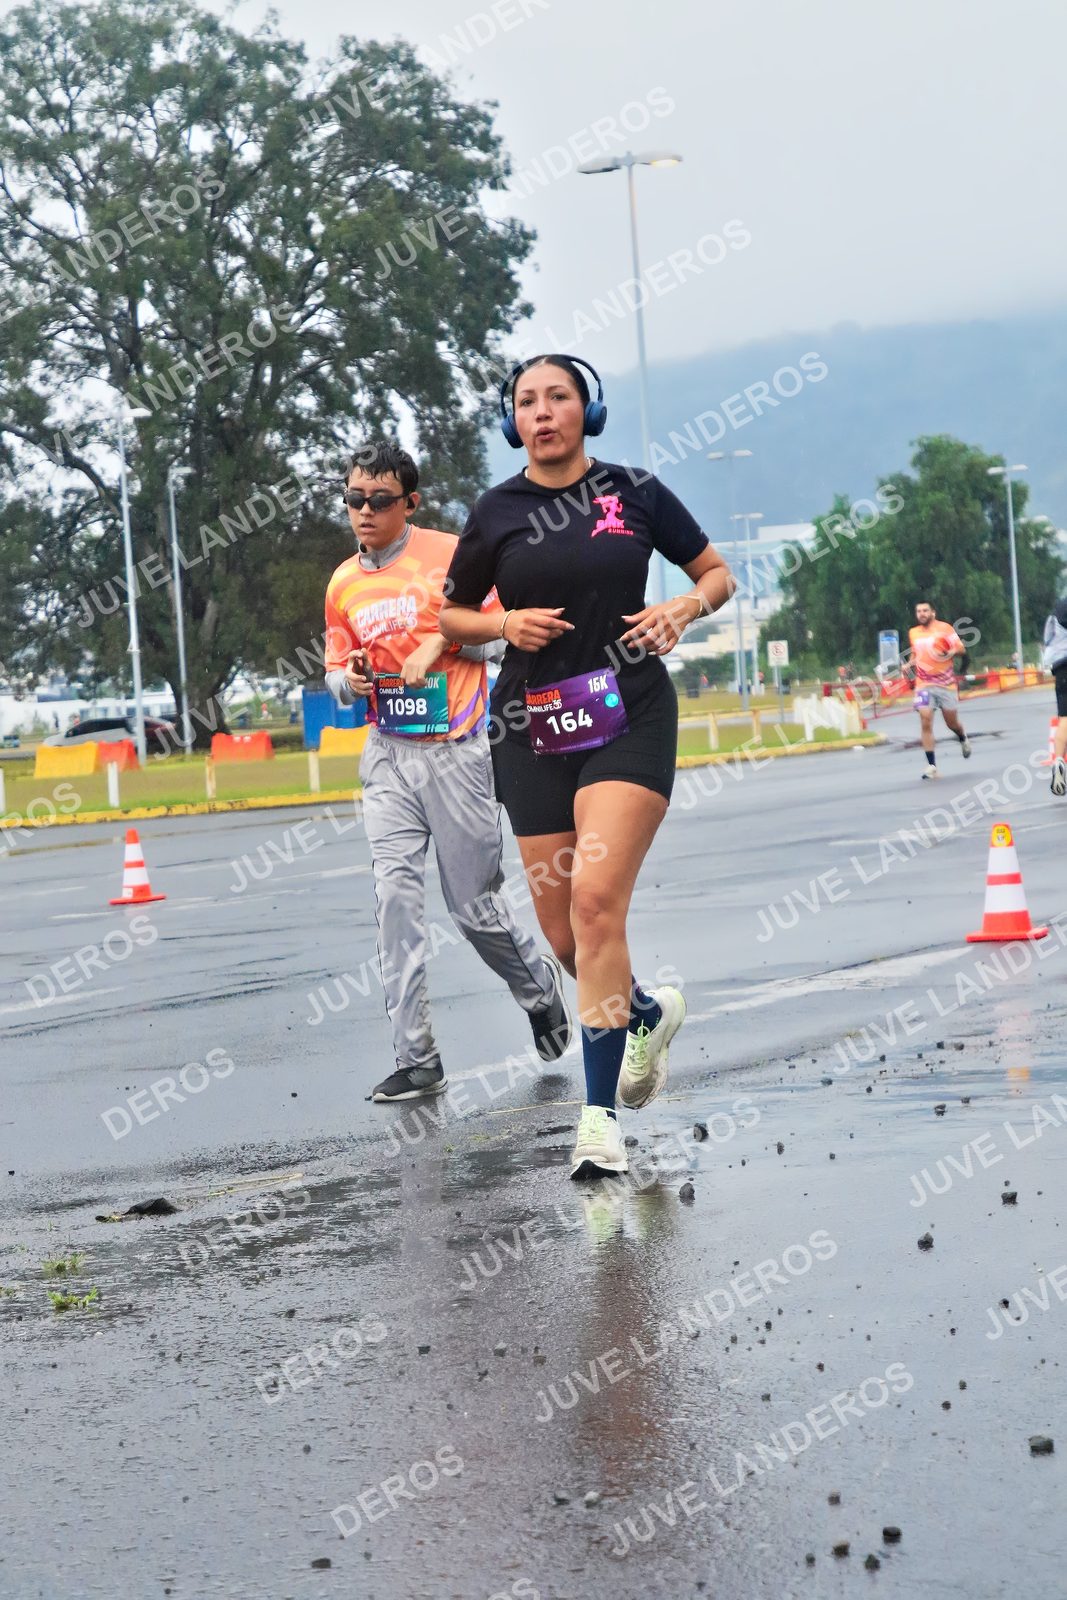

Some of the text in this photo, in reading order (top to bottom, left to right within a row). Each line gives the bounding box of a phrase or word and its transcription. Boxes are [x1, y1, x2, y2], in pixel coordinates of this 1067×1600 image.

[356, 596, 417, 628] CARRERA
[386, 698, 428, 716] 1098
[546, 708, 593, 735] 164
